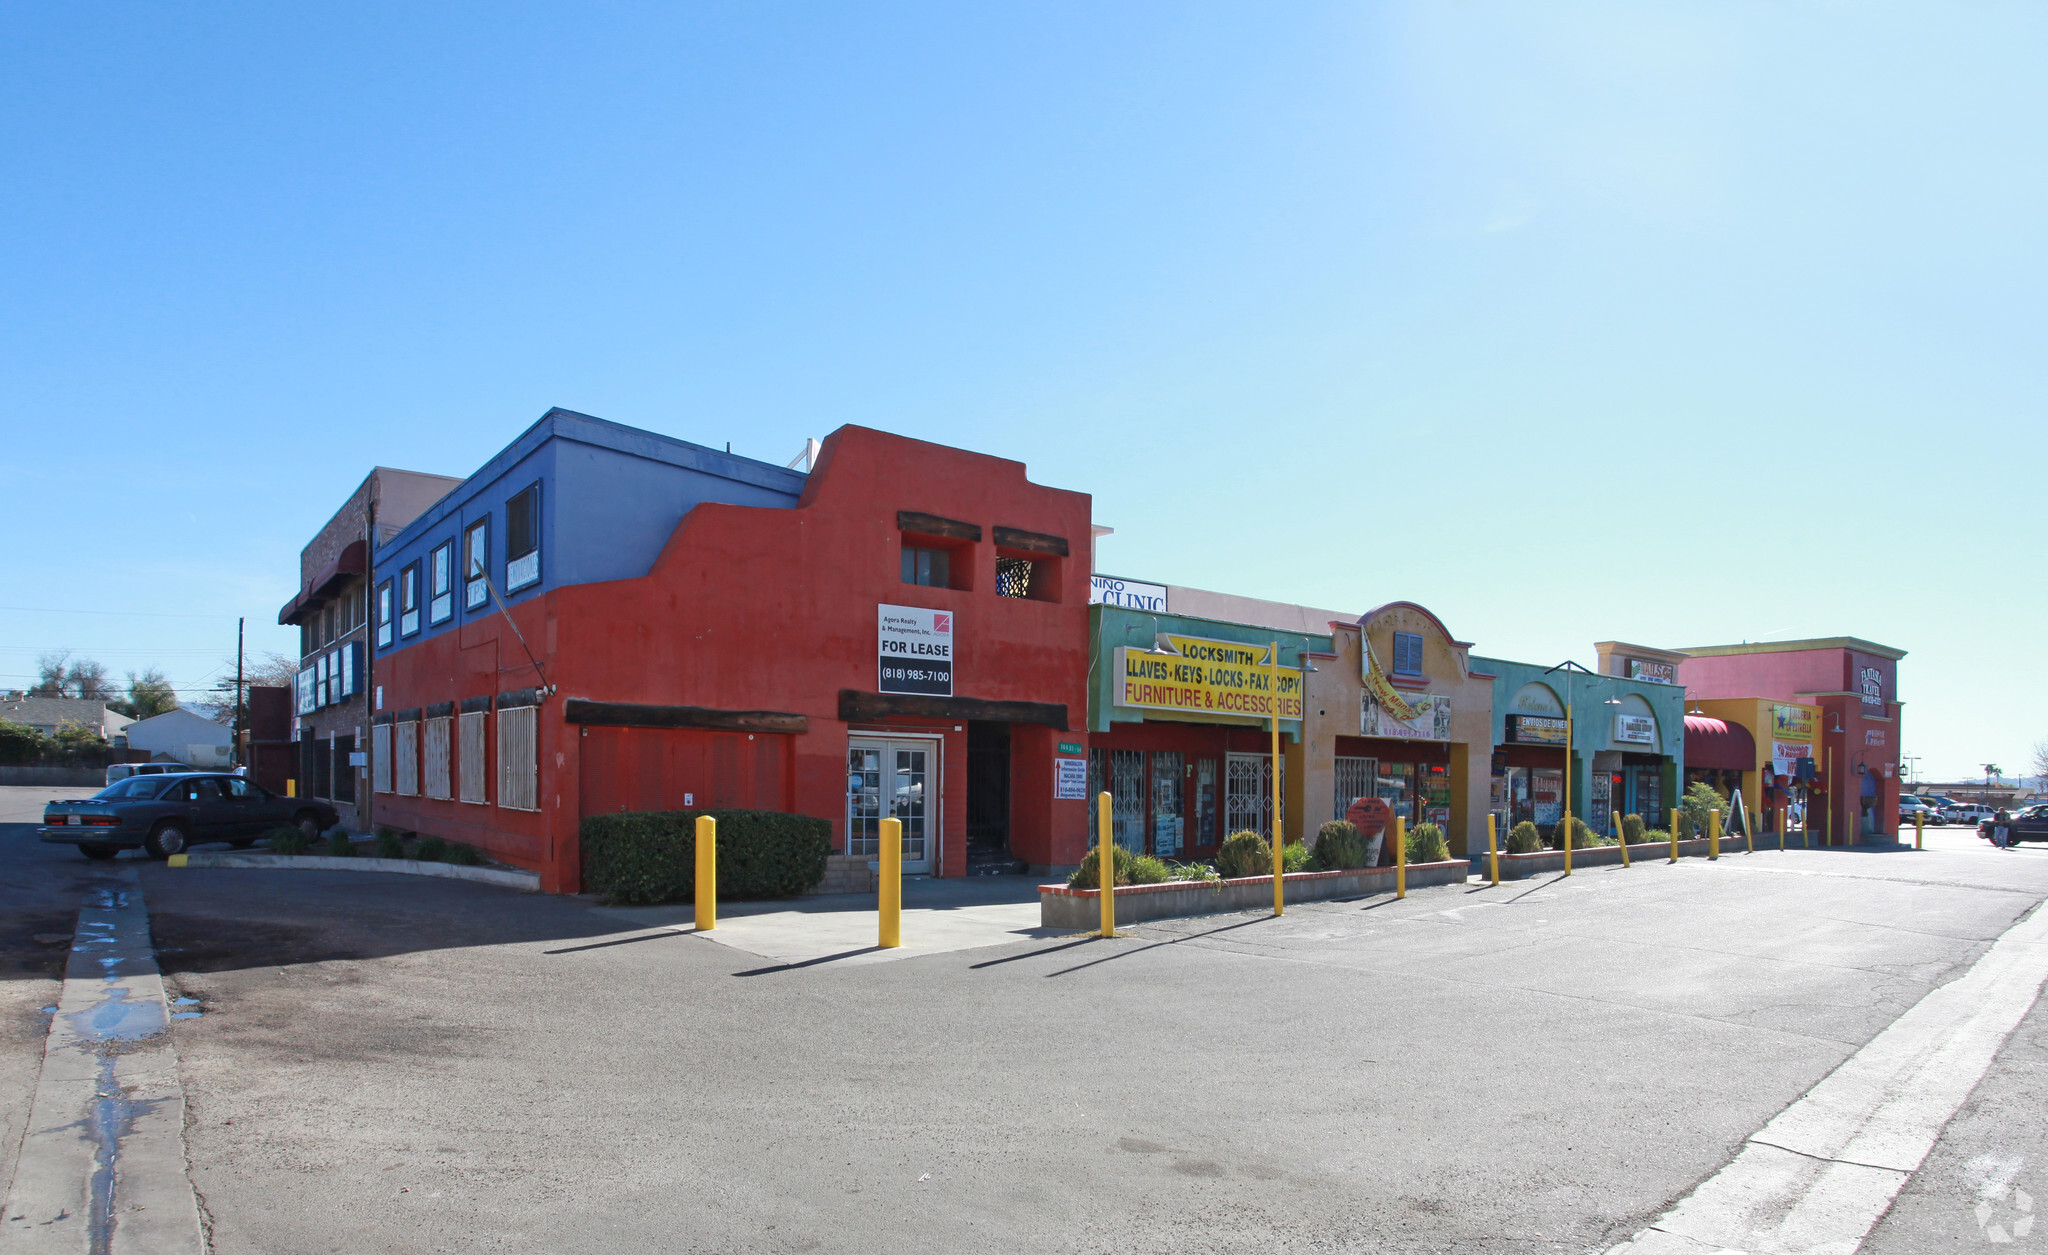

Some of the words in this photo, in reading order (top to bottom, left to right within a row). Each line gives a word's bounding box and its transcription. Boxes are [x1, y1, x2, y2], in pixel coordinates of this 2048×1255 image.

[1103, 590, 1164, 611] CLINIC
[883, 616, 899, 624] Agora
[900, 618, 917, 626] Realty
[887, 626, 921, 635] Management,
[882, 640, 907, 653] FOR
[911, 643, 949, 656] LEASE
[1182, 643, 1254, 666] LOCKSMITH
[882, 667, 905, 681] (818)
[907, 669, 949, 682] 985-7100
[1126, 658, 1168, 680] LLAVES
[1174, 664, 1202, 684] KEYS
[1209, 668, 1243, 688] LOCKS
[1250, 673, 1270, 691] FAX
[1125, 682, 1202, 708] FURNITURE
[1204, 691, 1213, 709] &
[1217, 691, 1301, 716] ACCESSORIES
[1522, 717, 1543, 727] ENVIOS
[1543, 719, 1551, 728] DE
[1552, 720, 1567, 729] DINER
[1186, 764, 1193, 778] F
